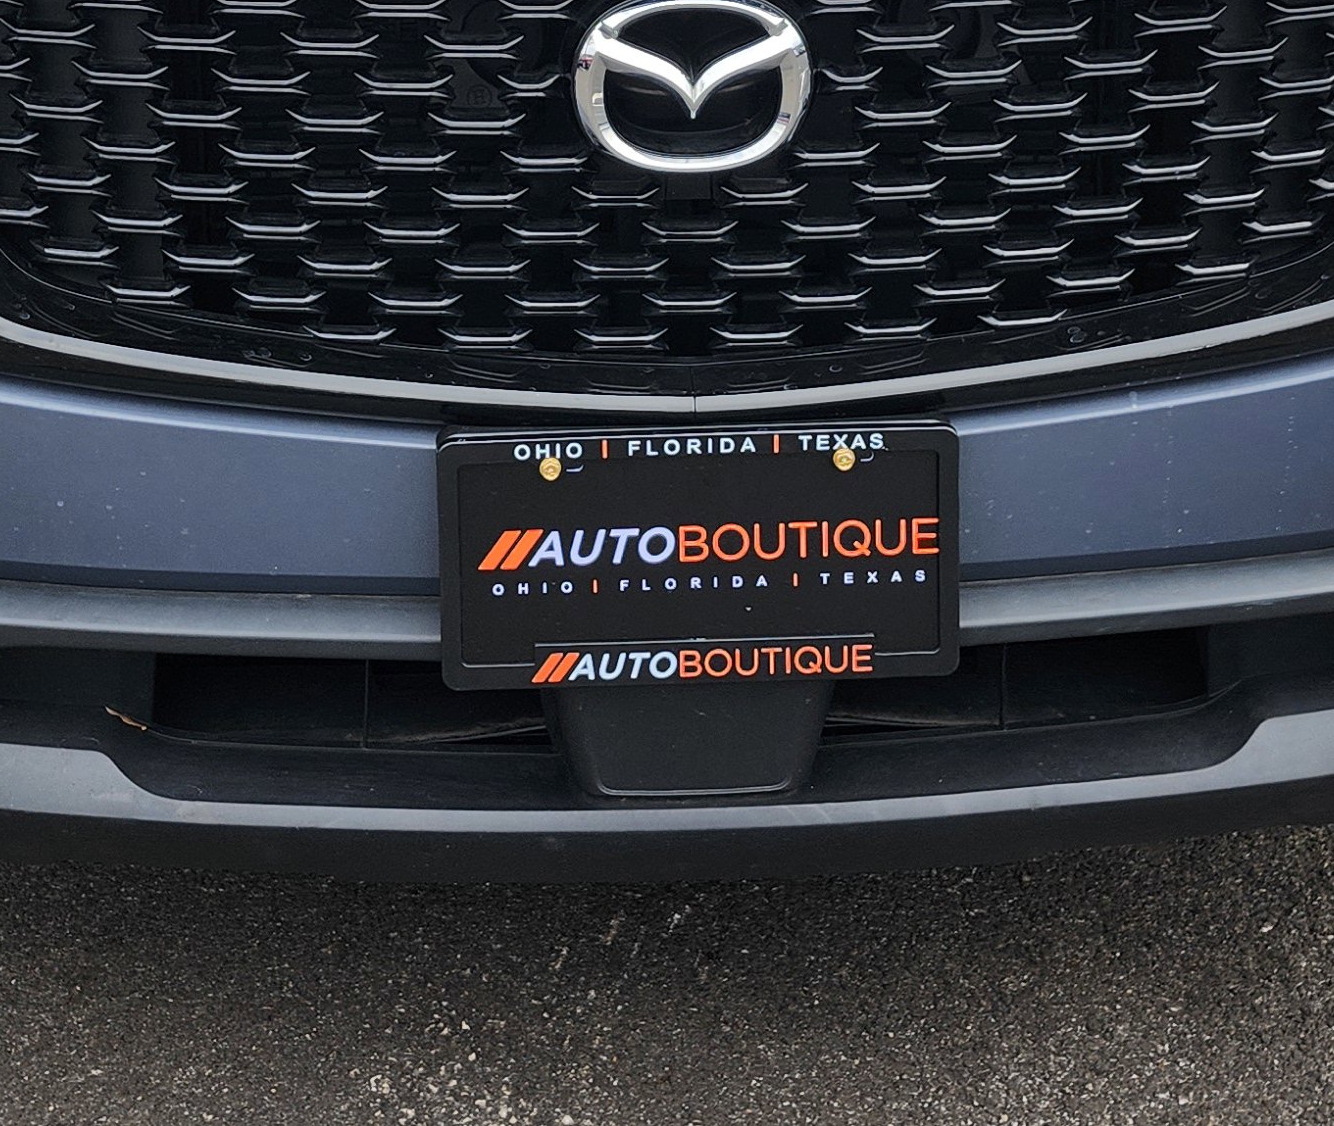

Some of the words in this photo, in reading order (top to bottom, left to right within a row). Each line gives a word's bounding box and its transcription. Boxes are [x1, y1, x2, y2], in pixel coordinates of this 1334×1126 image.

[513, 442, 584, 461] OHIO
[627, 436, 757, 457] FLORIDA
[797, 432, 885, 452] TEXAS
[527, 517, 940, 568] AUTOBOUTIQUE
[491, 581, 575, 597] OHIO
[619, 575, 769, 592] FLORIDA
[819, 568, 927, 586] TEXAS
[568, 643, 874, 682] AUTOBOUTIQUE
